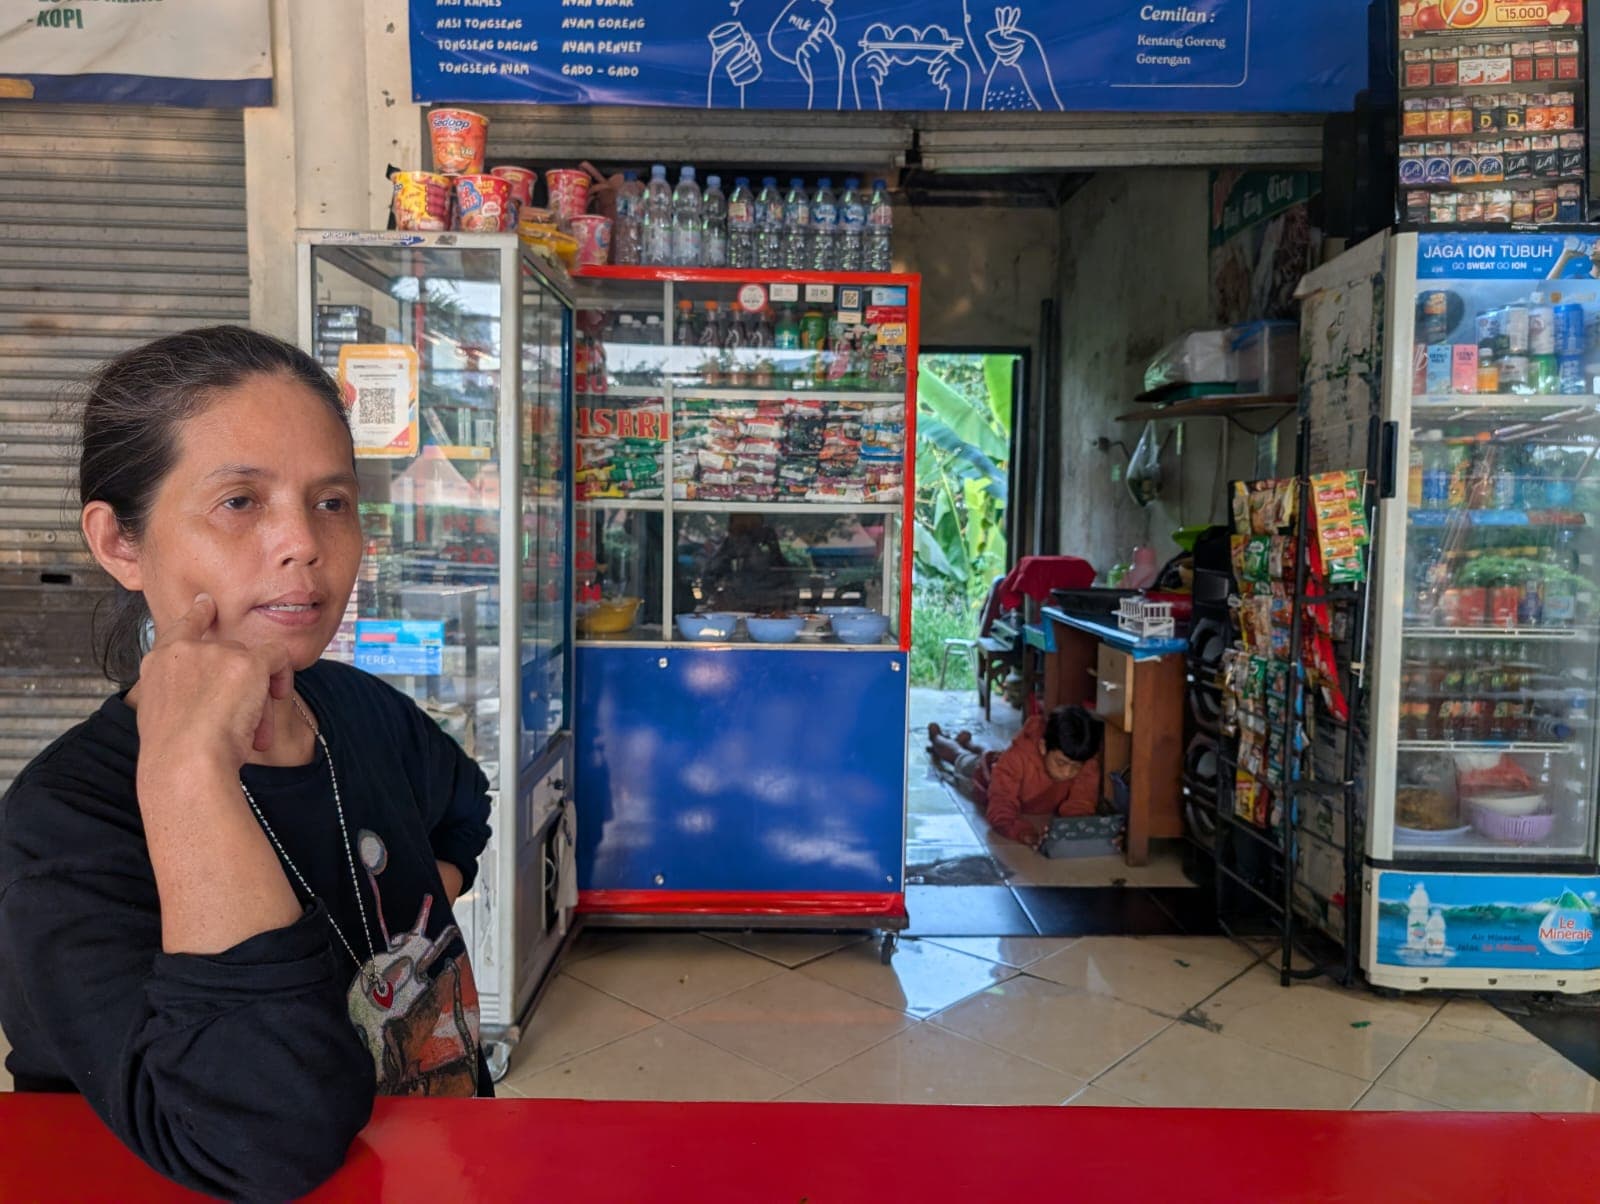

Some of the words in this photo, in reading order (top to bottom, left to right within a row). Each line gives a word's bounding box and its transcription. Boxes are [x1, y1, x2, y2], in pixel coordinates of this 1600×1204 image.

[37, 9, 84, 29] KOPI
[1504, 7, 1544, 20] 15.000
[437, 18, 461, 29] NASI
[464, 19, 523, 29] TONGSENG
[562, 18, 595, 29] AYAM
[598, 19, 645, 29] GORENG
[438, 40, 494, 51] TONGSENG
[497, 41, 538, 51] DAGING
[562, 41, 595, 53] AYAM
[598, 42, 642, 53] PENYET
[1137, 34, 1184, 48] Kentang
[1184, 36, 1226, 49] Goreng
[1136, 53, 1190, 67] Gorengan
[438, 62, 497, 74] TONGSENG
[500, 64, 529, 75] AYAM
[562, 65, 593, 76] GADO
[608, 66, 639, 77] GADO
[1424, 245, 1464, 258] JAGA
[1468, 245, 1496, 258] ION
[1500, 245, 1552, 258] TUBUH
[1452, 262, 1465, 270] GO
[1467, 262, 1495, 270] SWEAT
[1497, 262, 1510, 270] GO
[1511, 262, 1527, 270] ION
[359, 655, 396, 665] TEREA
[1559, 916, 1575, 929] Le
[1539, 926, 1593, 941] Minerale
